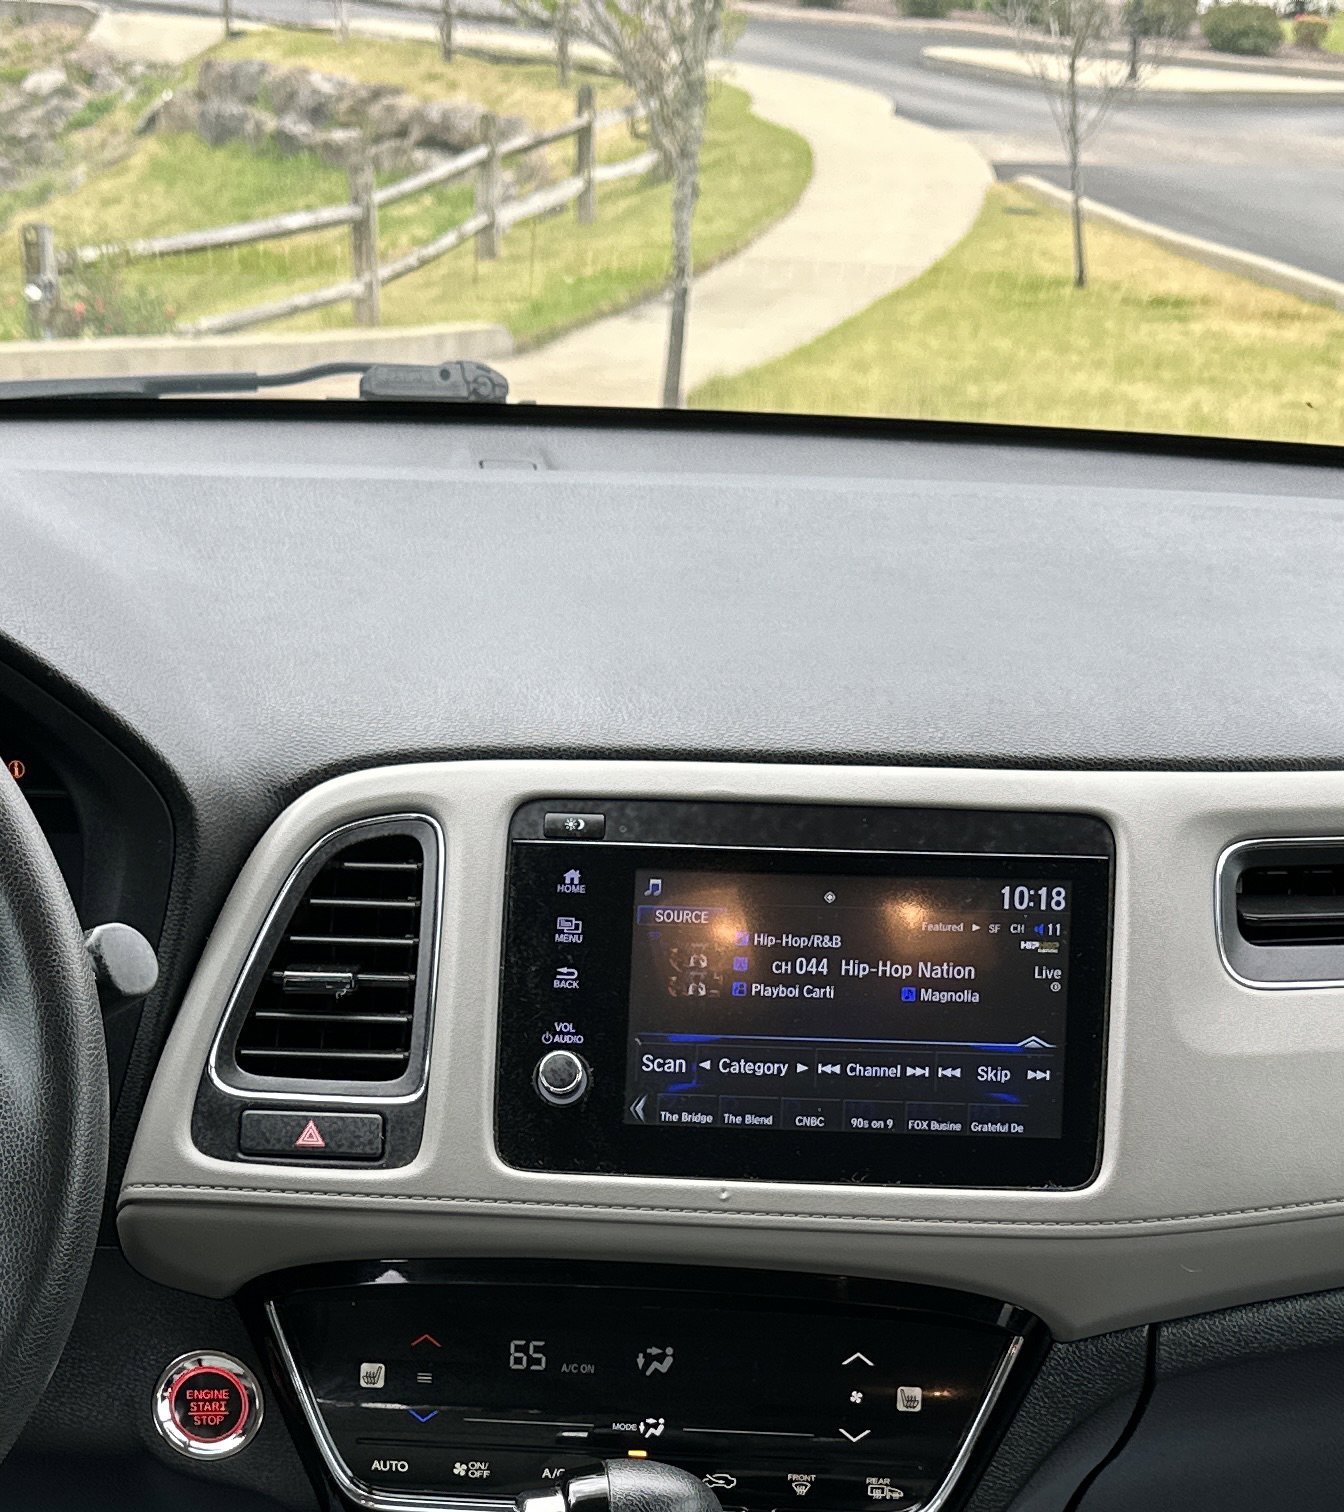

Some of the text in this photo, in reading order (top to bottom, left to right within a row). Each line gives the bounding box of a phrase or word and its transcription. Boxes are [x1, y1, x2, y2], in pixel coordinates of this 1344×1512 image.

[557, 884, 586, 894] HOME
[1000, 885, 1066, 911] 10:18
[655, 909, 709, 924] SOURCE
[921, 921, 964, 933] Featured
[988, 922, 1025, 934] SF CH
[1046, 923, 1061, 936] 11
[555, 933, 584, 944] MENU
[753, 932, 842, 949] Hip-Hop/R&B
[772, 957, 976, 980] CH 044 Hip-Hop Nation
[1034, 965, 1062, 980] Live
[553, 979, 580, 989] BACK
[751, 983, 835, 1000] Playboi Carti
[920, 988, 980, 1004] Magnolia
[554, 1021, 576, 1033] VOL
[553, 1034, 585, 1044] AUDIO
[641, 1054, 686, 1073] Scan
[718, 1057, 789, 1077] Category
[846, 1063, 901, 1078] Channel
[977, 1065, 1011, 1083] Skip
[660, 1111, 714, 1124] The Bridge
[723, 1113, 773, 1126] The Blend
[795, 1116, 825, 1127] CNBC
[850, 1118, 894, 1129] 90s on 9
[908, 1120, 962, 1132] FOX Busine
[970, 1121, 1024, 1133] Grateful De
[509, 1340, 595, 1375] 65 A/C ON
[186, 1389, 230, 1400] ENGINE
[189, 1401, 227, 1412] START
[193, 1415, 225, 1426] STOP
[612, 1422, 638, 1432] MODE
[371, 1459, 409, 1473] AUTO
[468, 1461, 489, 1471] ON/
[468, 1469, 491, 1479] OFF
[787, 1473, 816, 1482] FRONT
[866, 1477, 891, 1486] REAR
